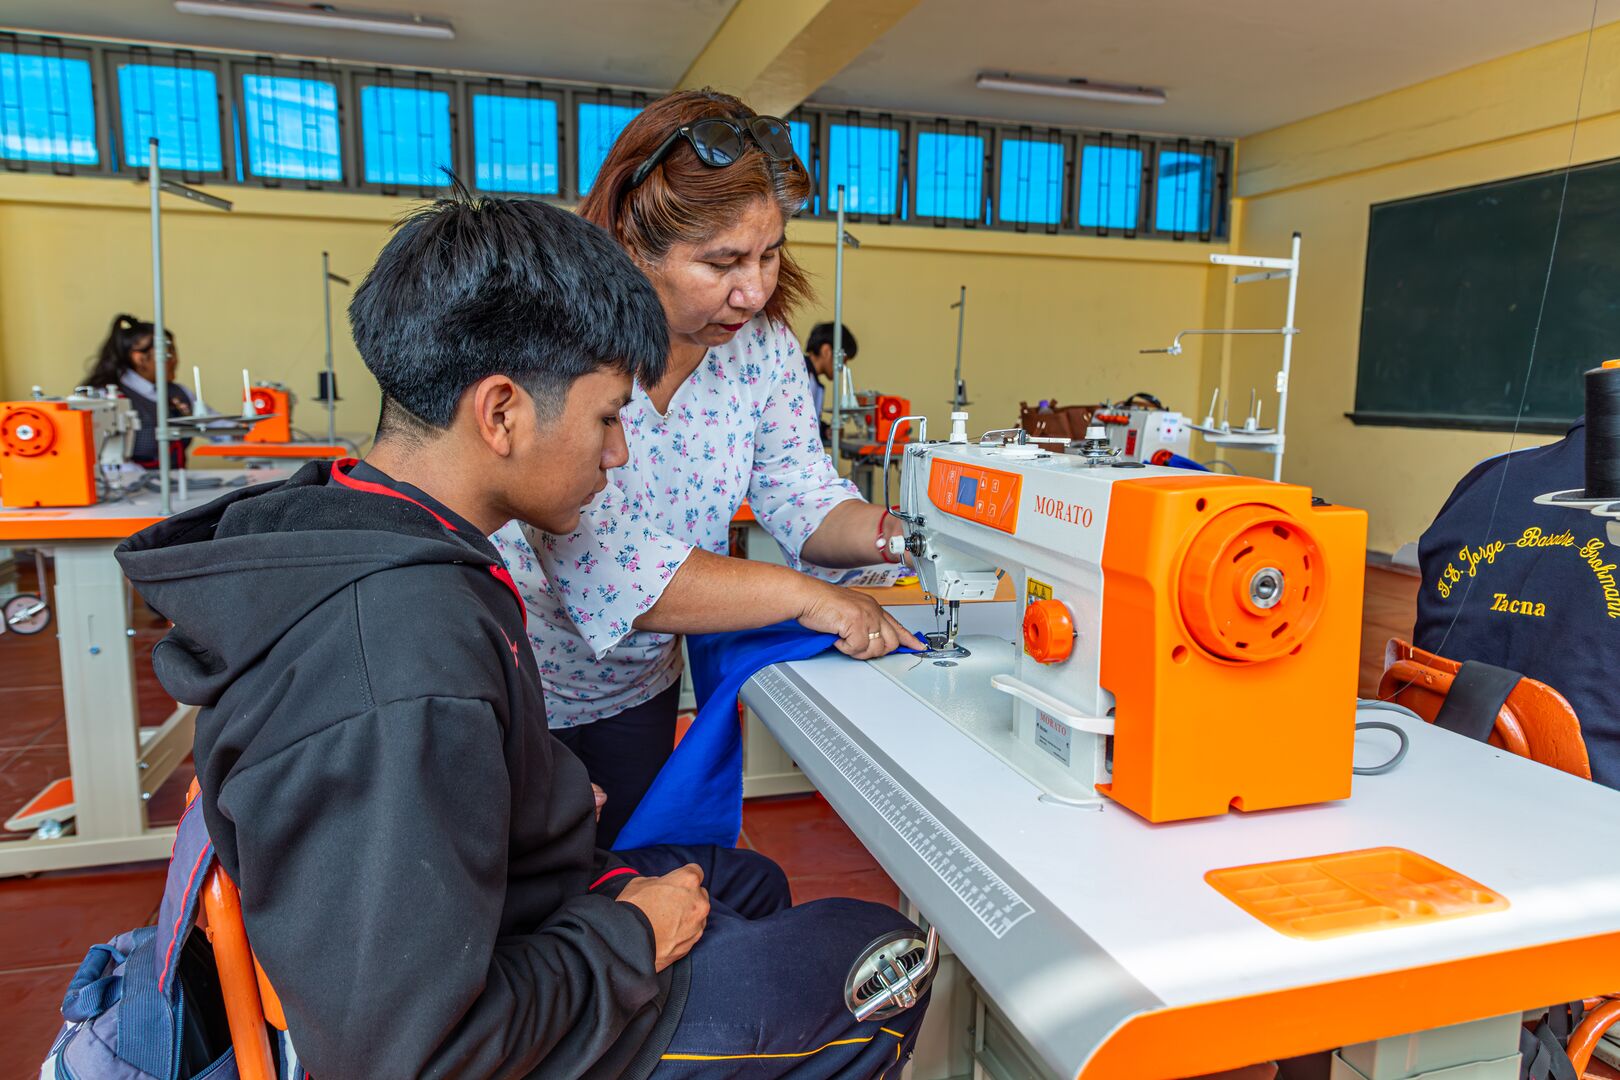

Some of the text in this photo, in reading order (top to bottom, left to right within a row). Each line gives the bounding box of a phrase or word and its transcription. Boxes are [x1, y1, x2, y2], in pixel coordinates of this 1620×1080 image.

[1034, 494, 1093, 528] MORATO
[1459, 541, 1506, 577] Jorge
[1490, 593, 1546, 617] Tacna
